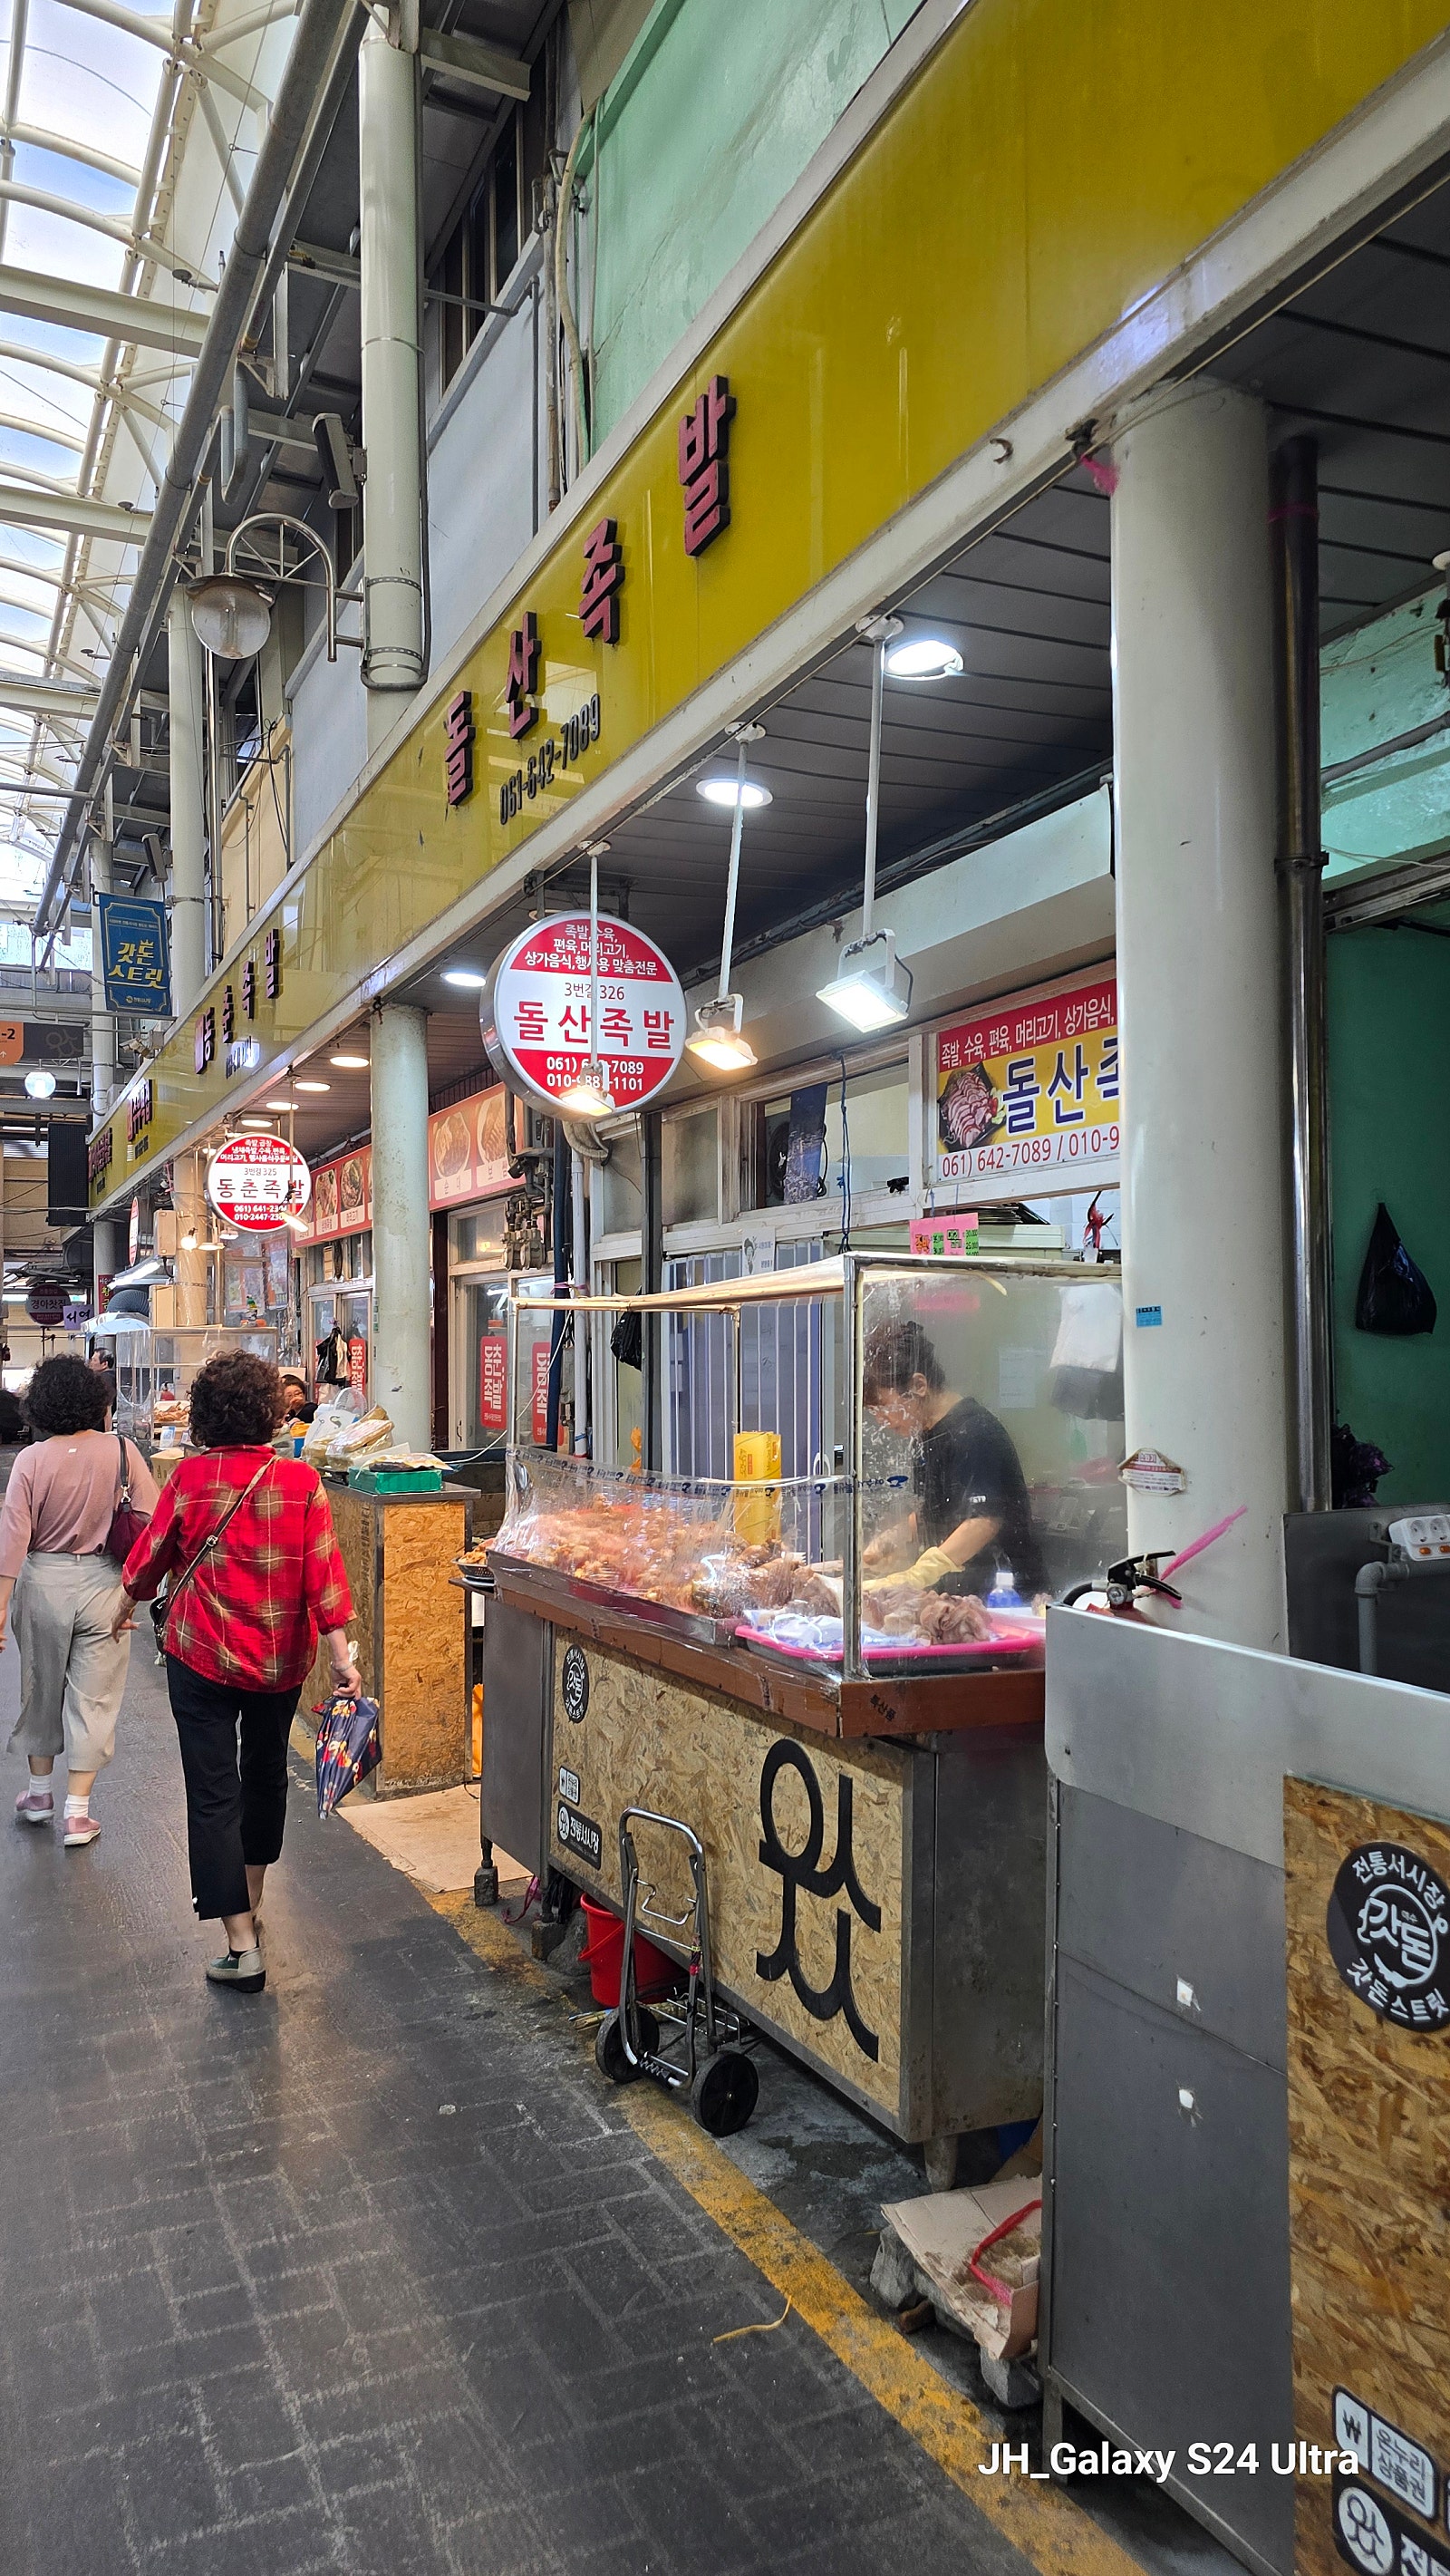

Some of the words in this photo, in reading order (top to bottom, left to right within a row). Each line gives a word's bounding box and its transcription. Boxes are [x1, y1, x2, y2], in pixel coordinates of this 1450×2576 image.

[500, 693, 600, 825] 061-642-7089
[613, 958, 658, 975] 맞춤전문
[599, 985, 624, 1001] 326
[514, 1001, 675, 1050] 돌산족발
[942, 1041, 962, 1069] 족발,
[963, 1032, 986, 1062] 수육,
[989, 1024, 1012, 1054] 편육,
[1016, 1010, 1061, 1048] 머리고기,
[1065, 994, 1115, 1036] 상가음식,
[546, 1056, 577, 1073] 061)
[582, 1058, 644, 1075] 6-7089
[263, 1167, 277, 1176] 325
[942, 1156, 972, 1177] 061)
[978, 1138, 1051, 1172] 642-7089
[218, 1178, 304, 1199] 동춘족발
[570, 1816, 599, 1855] 전통서시장
[1352, 1851, 1446, 1910] 전통서시장
[1347, 1957, 1450, 2021] 갓돈스트릿
